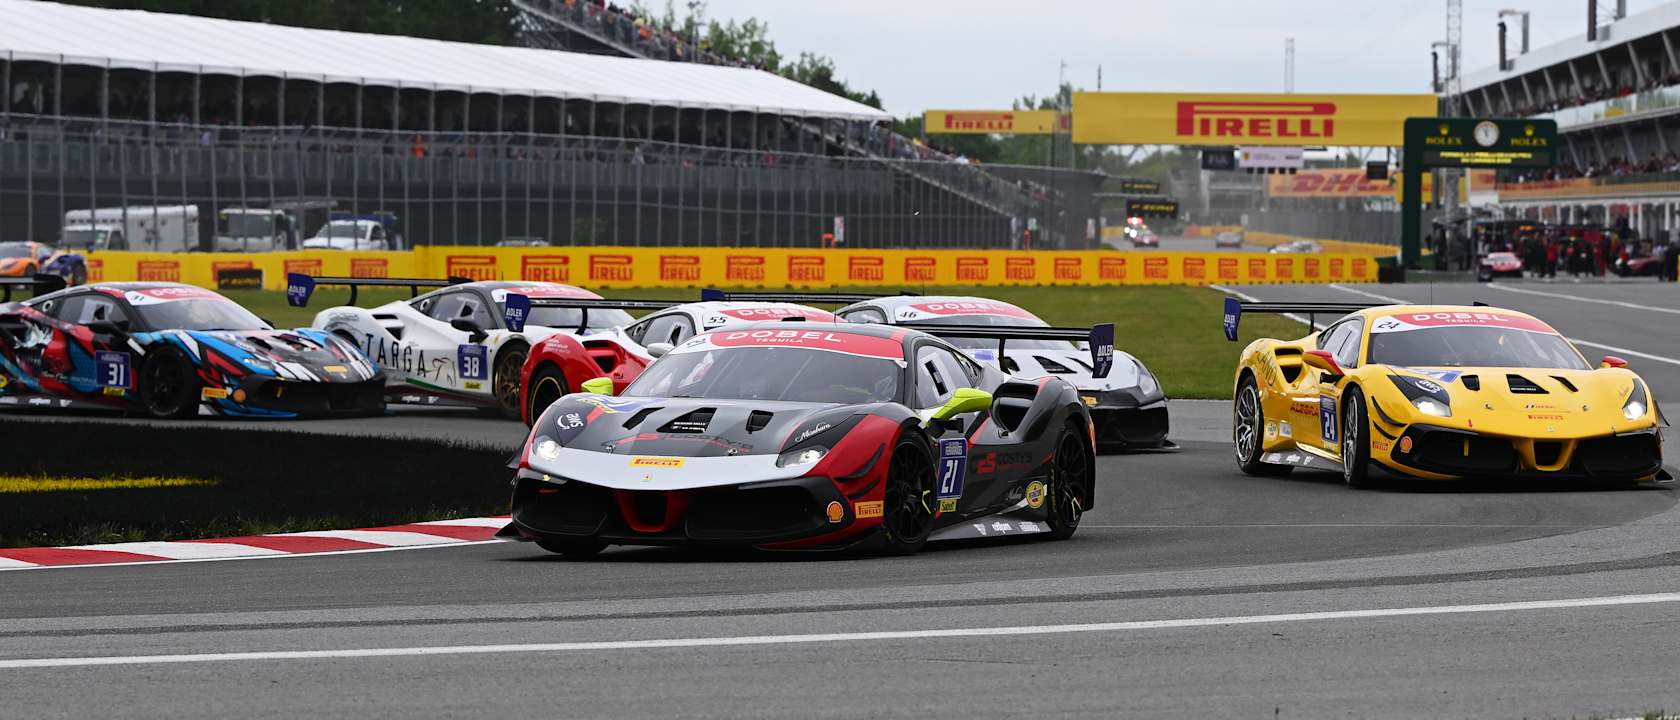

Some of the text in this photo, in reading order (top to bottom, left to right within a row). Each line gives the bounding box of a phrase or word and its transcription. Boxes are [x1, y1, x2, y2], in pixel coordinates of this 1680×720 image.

[944, 113, 1014, 129] PIRELLI
[1176, 102, 1337, 137] PIRELLI
[1426, 137, 1462, 145] ROLEX
[1511, 138, 1547, 146] ROLEX
[1292, 174, 1379, 192] DHL
[447, 256, 497, 281] PIRELLI
[521, 256, 570, 281] PIRELLI
[589, 255, 634, 281] PIRELLI
[659, 256, 701, 281] PIRELLI
[726, 256, 765, 281] PIRELLI
[788, 256, 826, 281] PIRELLI
[848, 256, 884, 281] PIRELLI
[905, 257, 937, 281] PIRELLI
[956, 257, 988, 281] PIRELLI
[1006, 257, 1035, 280] PIRELLI
[288, 285, 306, 295] ADLER
[506, 308, 523, 317] ADLER
[737, 308, 817, 316] DOBEL
[927, 302, 1006, 311] DOBEL
[1412, 312, 1509, 322] DOBEL
[1378, 321, 1400, 330] 24
[726, 330, 842, 343] DOBEL
[365, 333, 426, 378] TARGA
[1097, 345, 1113, 356] ADLER
[108, 363, 125, 385] 31
[463, 356, 480, 377] 38
[1324, 412, 1335, 440] 24
[634, 458, 680, 467] PIRELLI
[940, 459, 959, 494] 21
[858, 503, 881, 516] PIRELLI
